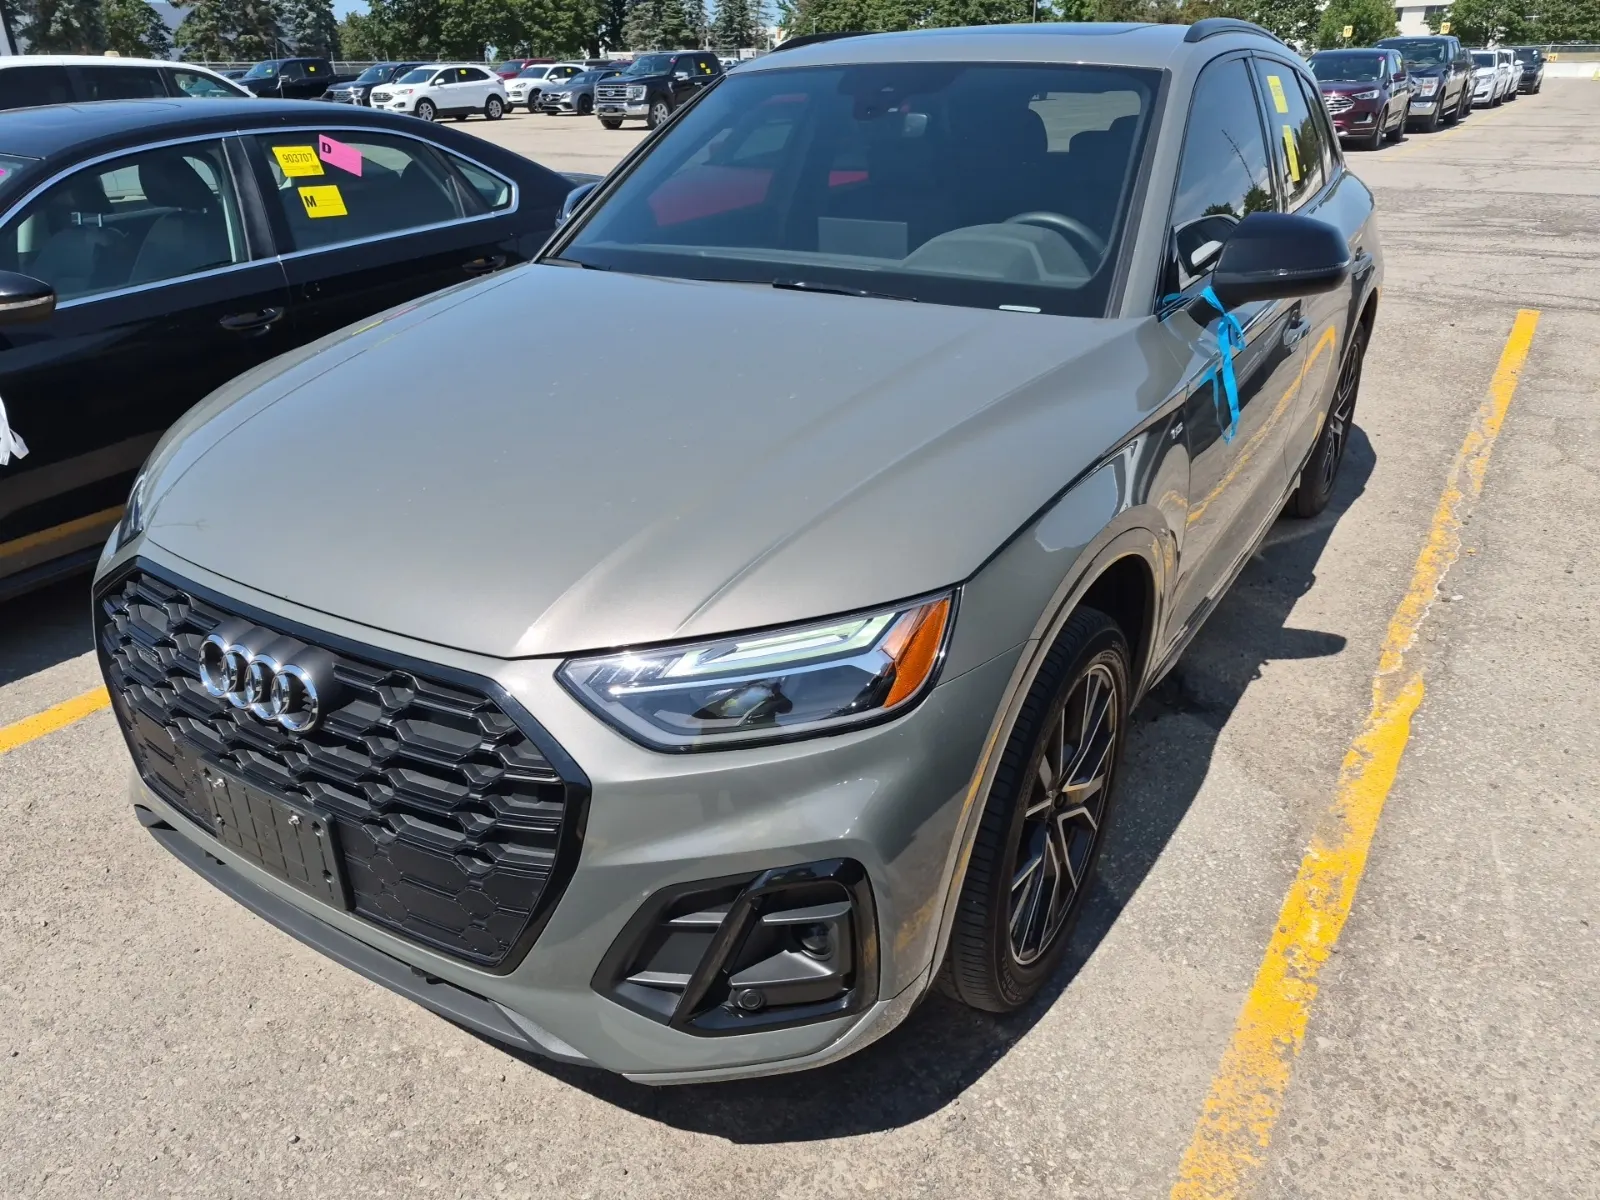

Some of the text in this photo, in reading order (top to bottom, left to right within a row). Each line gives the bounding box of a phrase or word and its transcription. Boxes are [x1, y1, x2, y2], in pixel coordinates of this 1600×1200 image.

[321, 142, 332, 154] D
[282, 153, 313, 163] 903707
[303, 195, 318, 208] M
